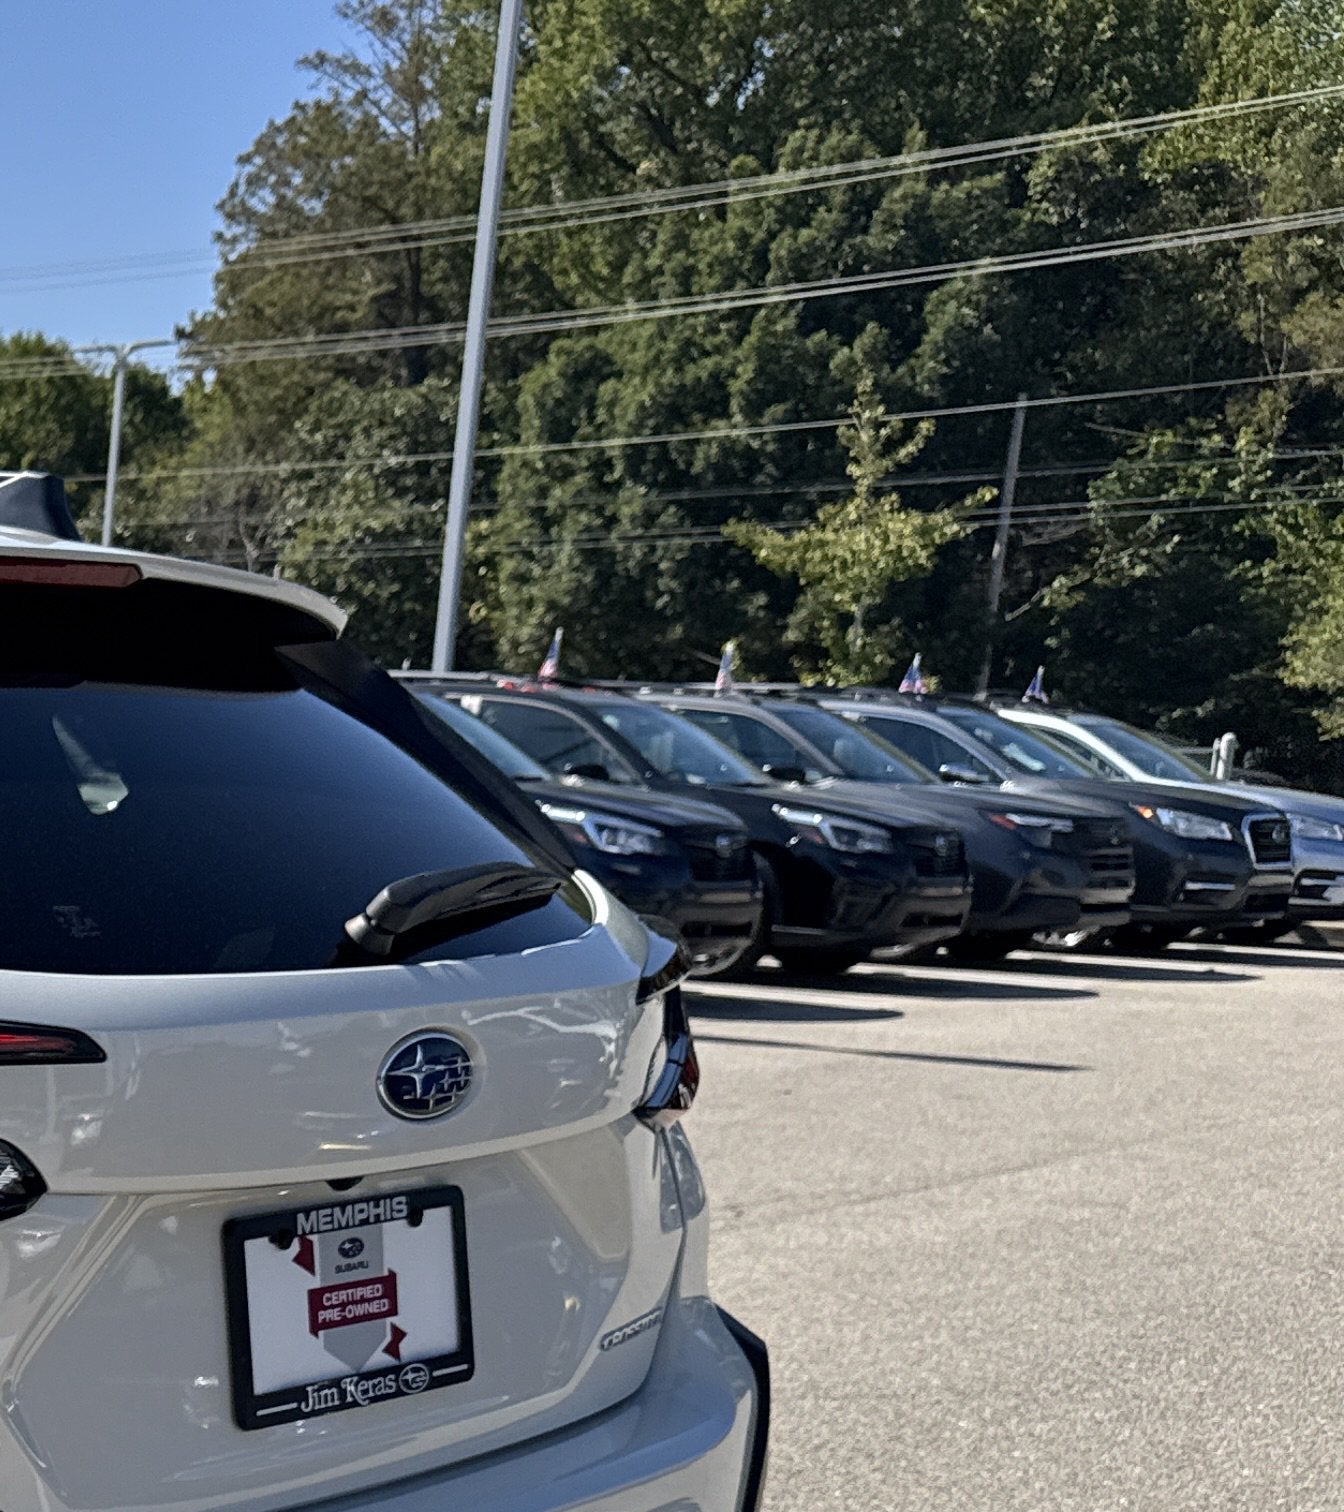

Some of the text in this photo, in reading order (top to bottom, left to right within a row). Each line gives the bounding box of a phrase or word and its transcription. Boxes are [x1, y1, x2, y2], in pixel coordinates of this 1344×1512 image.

[296, 1196, 407, 1235] MEMPHIS
[335, 1260, 369, 1274] SUBARU
[322, 1283, 384, 1307] CERTIFIED
[318, 1298, 390, 1324] PRE-OWNED
[301, 1374, 396, 1412] Jim Keras
